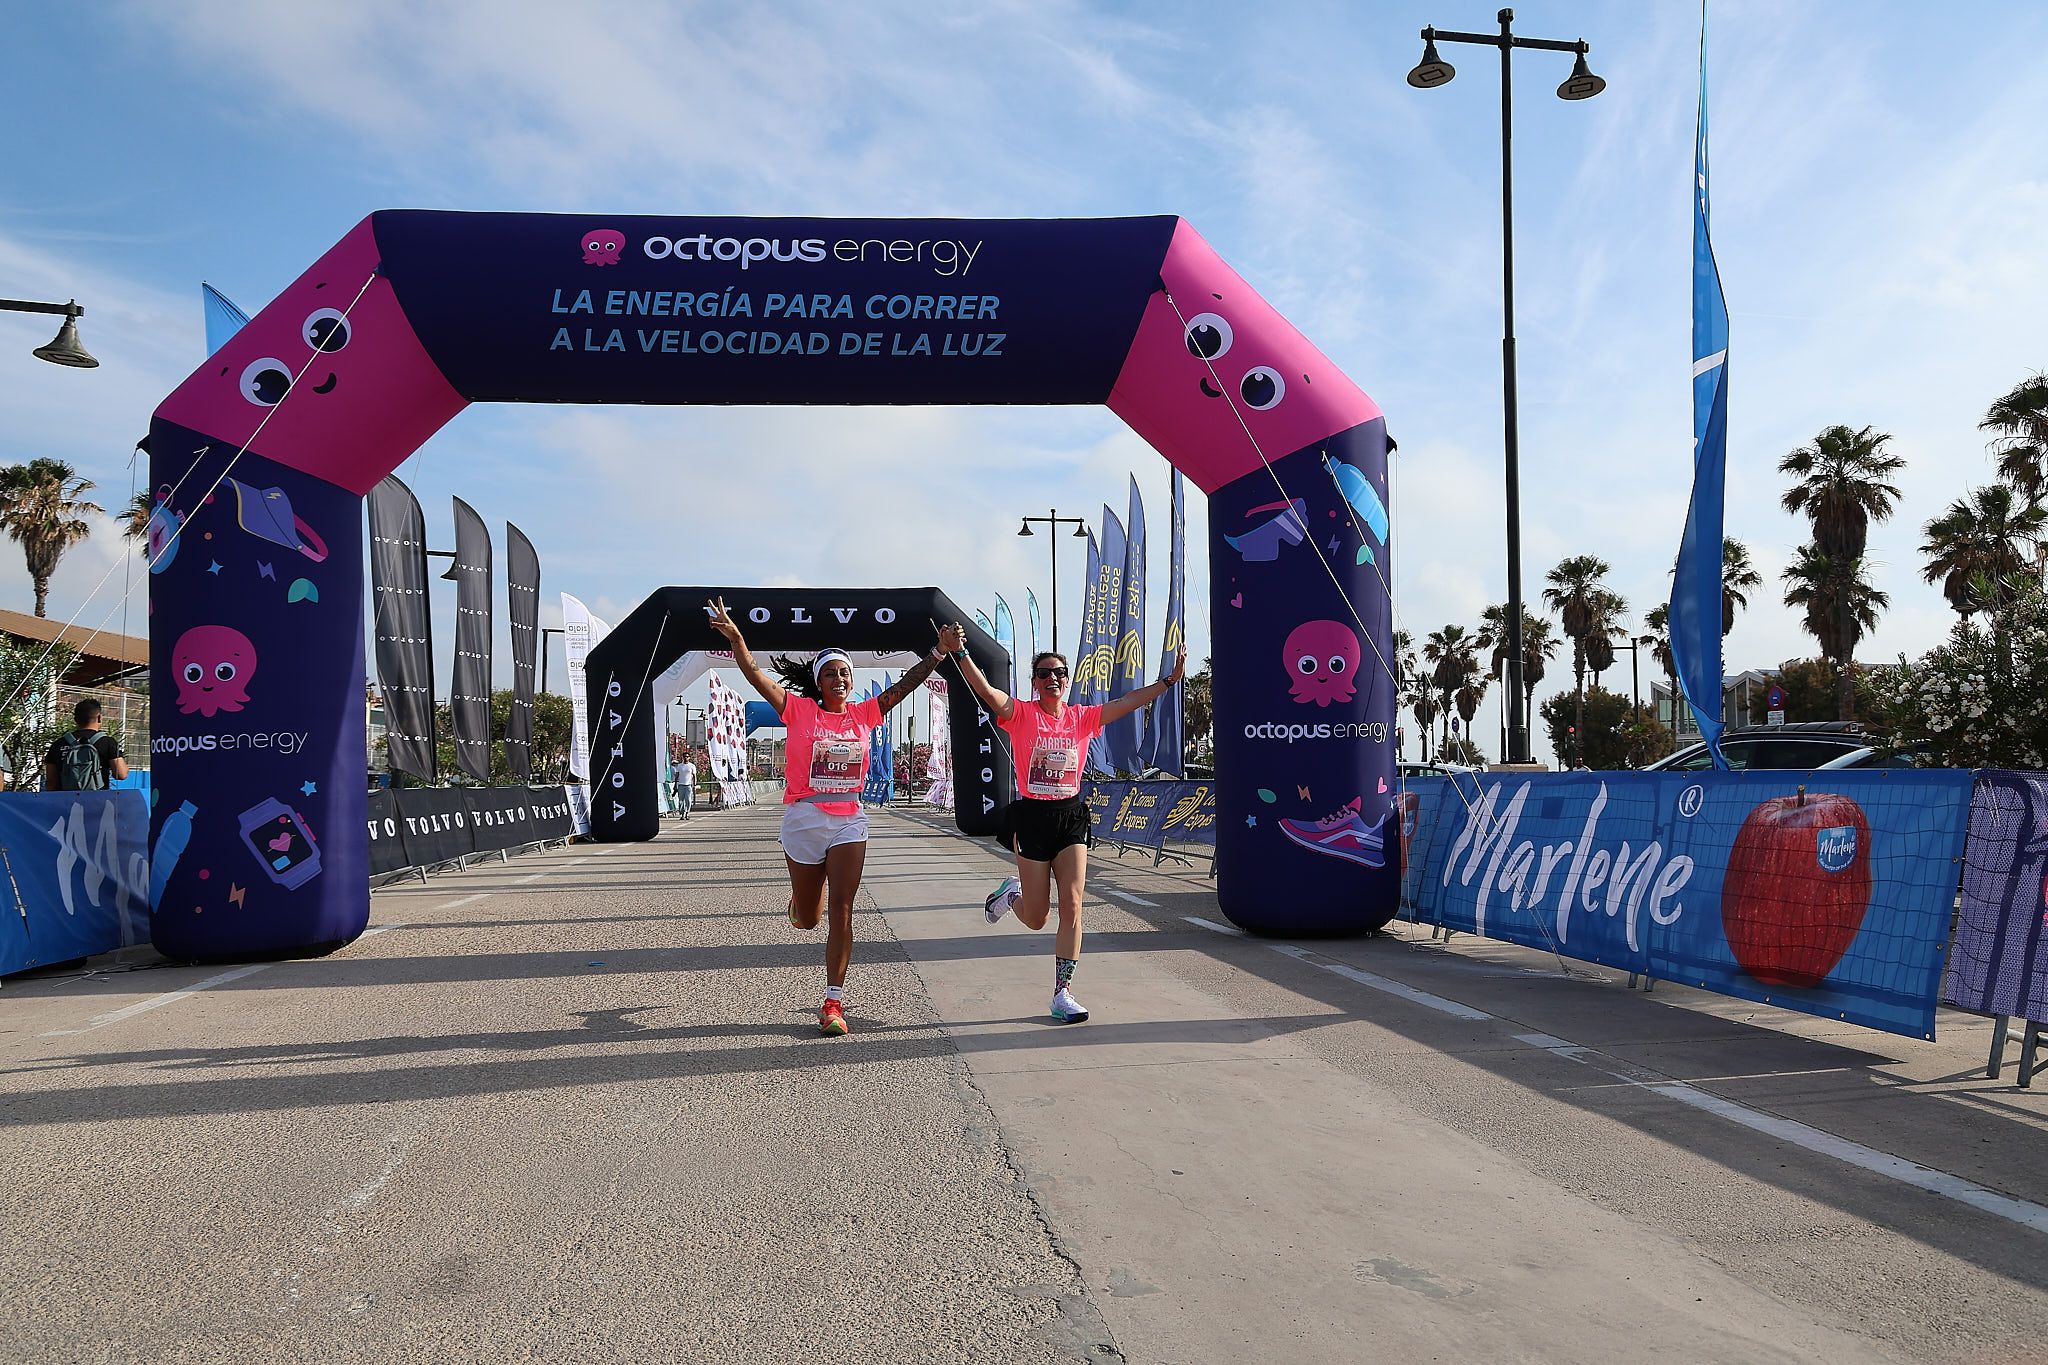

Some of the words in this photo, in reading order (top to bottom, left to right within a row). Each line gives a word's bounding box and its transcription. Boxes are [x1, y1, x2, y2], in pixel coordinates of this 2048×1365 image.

[643, 233, 827, 270] octopus
[833, 238, 983, 276] energy
[551, 288, 594, 314] LA
[604, 285, 754, 318] ENERGÍA
[763, 293, 855, 319] PARA
[864, 294, 1000, 320] CORRER
[549, 327, 574, 351] A
[583, 328, 627, 352] LA
[637, 329, 831, 355] VELOCIDAD
[838, 332, 884, 356] DE
[891, 332, 933, 356] LA
[941, 332, 1007, 356] LUZ
[702, 606, 897, 624] VOLVO
[151, 733, 217, 757] octopus
[219, 731, 309, 755] energy
[1244, 721, 1331, 744] octopus
[1333, 721, 1389, 744] energy
[609, 681, 626, 822] VOLVO
[978, 706, 995, 815] VOLV
[827, 762, 848, 771] 016
[1046, 770, 1065, 779] 016
[405, 811, 464, 836] VOLVO
[471, 806, 526, 827] VOLVO
[530, 802, 568, 820] VOLVO
[1820, 837, 1856, 862] Marlene
[1443, 780, 1695, 953] Marlene
